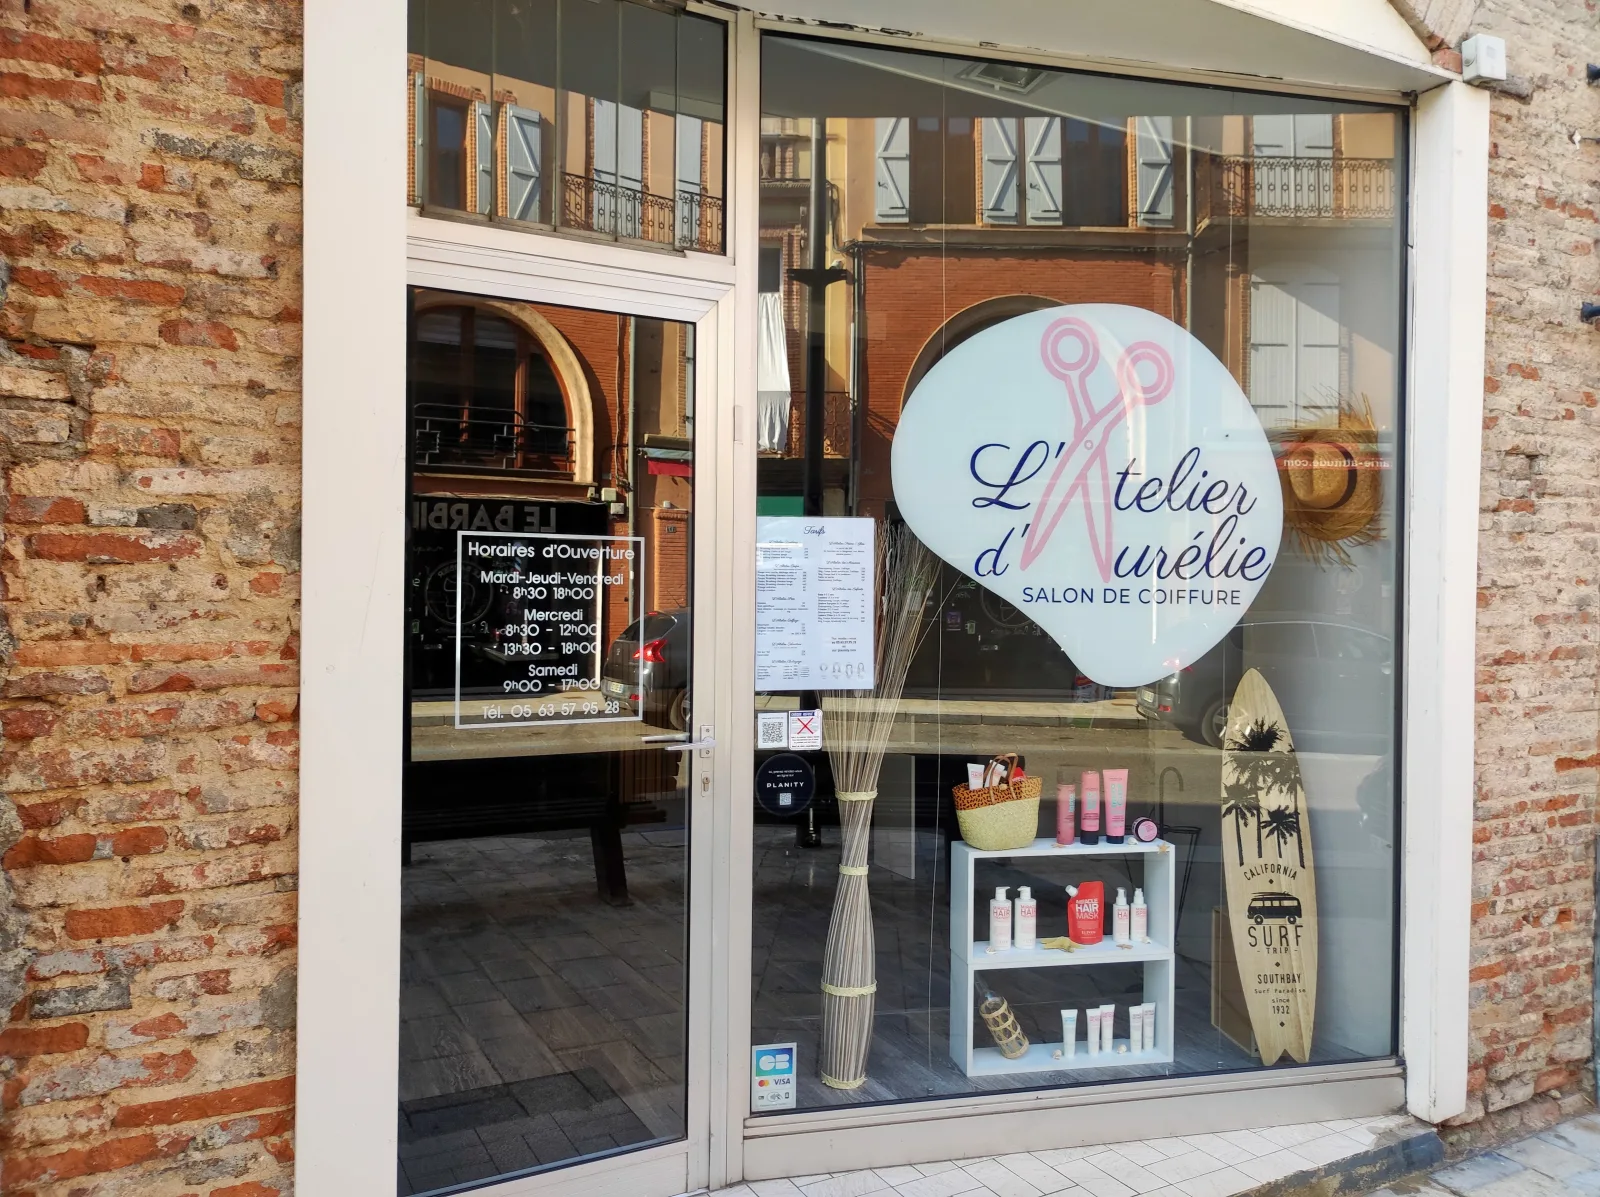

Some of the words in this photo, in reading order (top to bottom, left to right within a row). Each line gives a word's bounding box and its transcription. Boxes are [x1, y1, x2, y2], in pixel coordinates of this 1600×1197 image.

[803, 525, 826, 537] Tarifs
[468, 541, 535, 558] Horaires
[542, 544, 635, 560] d'Ouverture
[480, 570, 624, 585] Mardi-Jeudi-Vendredi
[512, 587, 547, 600] 8h30
[553, 587, 594, 600] 18h00
[1022, 587, 1094, 604] SALON
[1103, 587, 1131, 604] DE
[1138, 588, 1242, 605] COIFFURE
[523, 608, 583, 621] Mercredi
[505, 624, 540, 637] 8h30
[558, 623, 600, 636] 12h00
[503, 642, 541, 656] 13h30
[561, 641, 600, 655] 18h00
[528, 664, 578, 677] Samedi
[503, 679, 542, 693] 9h00
[561, 678, 601, 691] 17h00
[482, 703, 504, 719] Tél.
[510, 705, 532, 718] 05
[538, 704, 554, 717] 63
[561, 703, 576, 716] 57
[583, 702, 598, 715] 95
[604, 700, 620, 714] 28
[1243, 863, 1298, 881] CALIFORNIA
[1075, 903, 1099, 913] HAIR
[1075, 911, 1099, 920] MASK
[1247, 925, 1304, 947] SURF
[1257, 973, 1302, 985] SOUTHBAY
[1272, 1005, 1290, 1015] 1932
